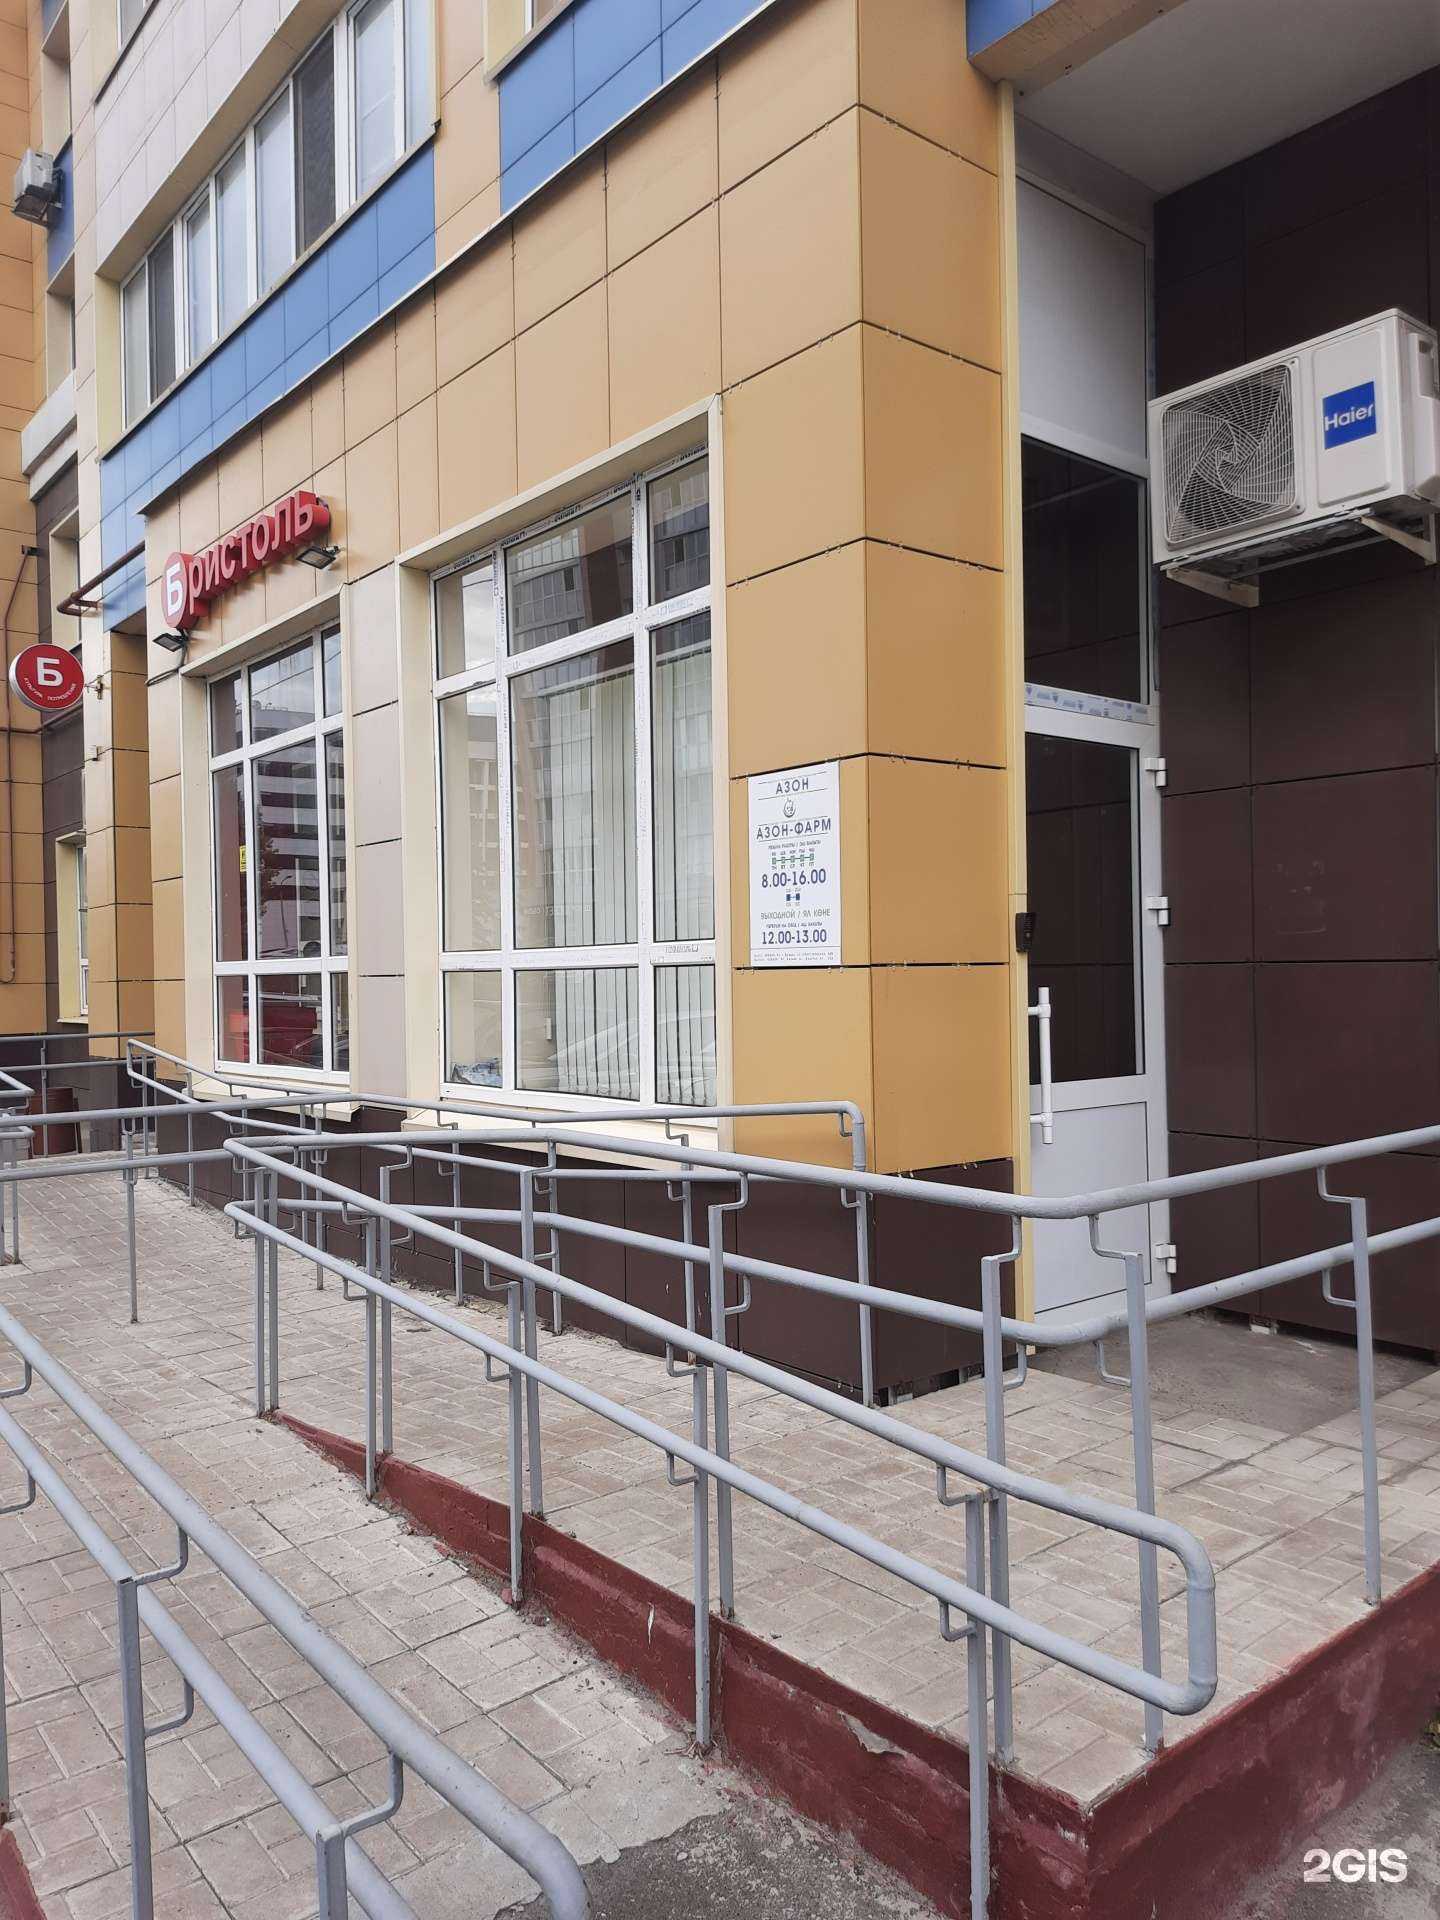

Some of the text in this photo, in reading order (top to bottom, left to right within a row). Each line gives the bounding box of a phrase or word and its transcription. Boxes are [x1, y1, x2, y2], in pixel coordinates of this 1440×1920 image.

[1324, 403, 1374, 431] Haier
[36, 656, 64, 687] Б
[775, 777, 809, 795] АЗОН
[756, 817, 831, 840] АЗОН-ФАРМ
[761, 868, 827, 888] 8.00-16.00
[762, 929, 827, 945] 12.00-13.00
